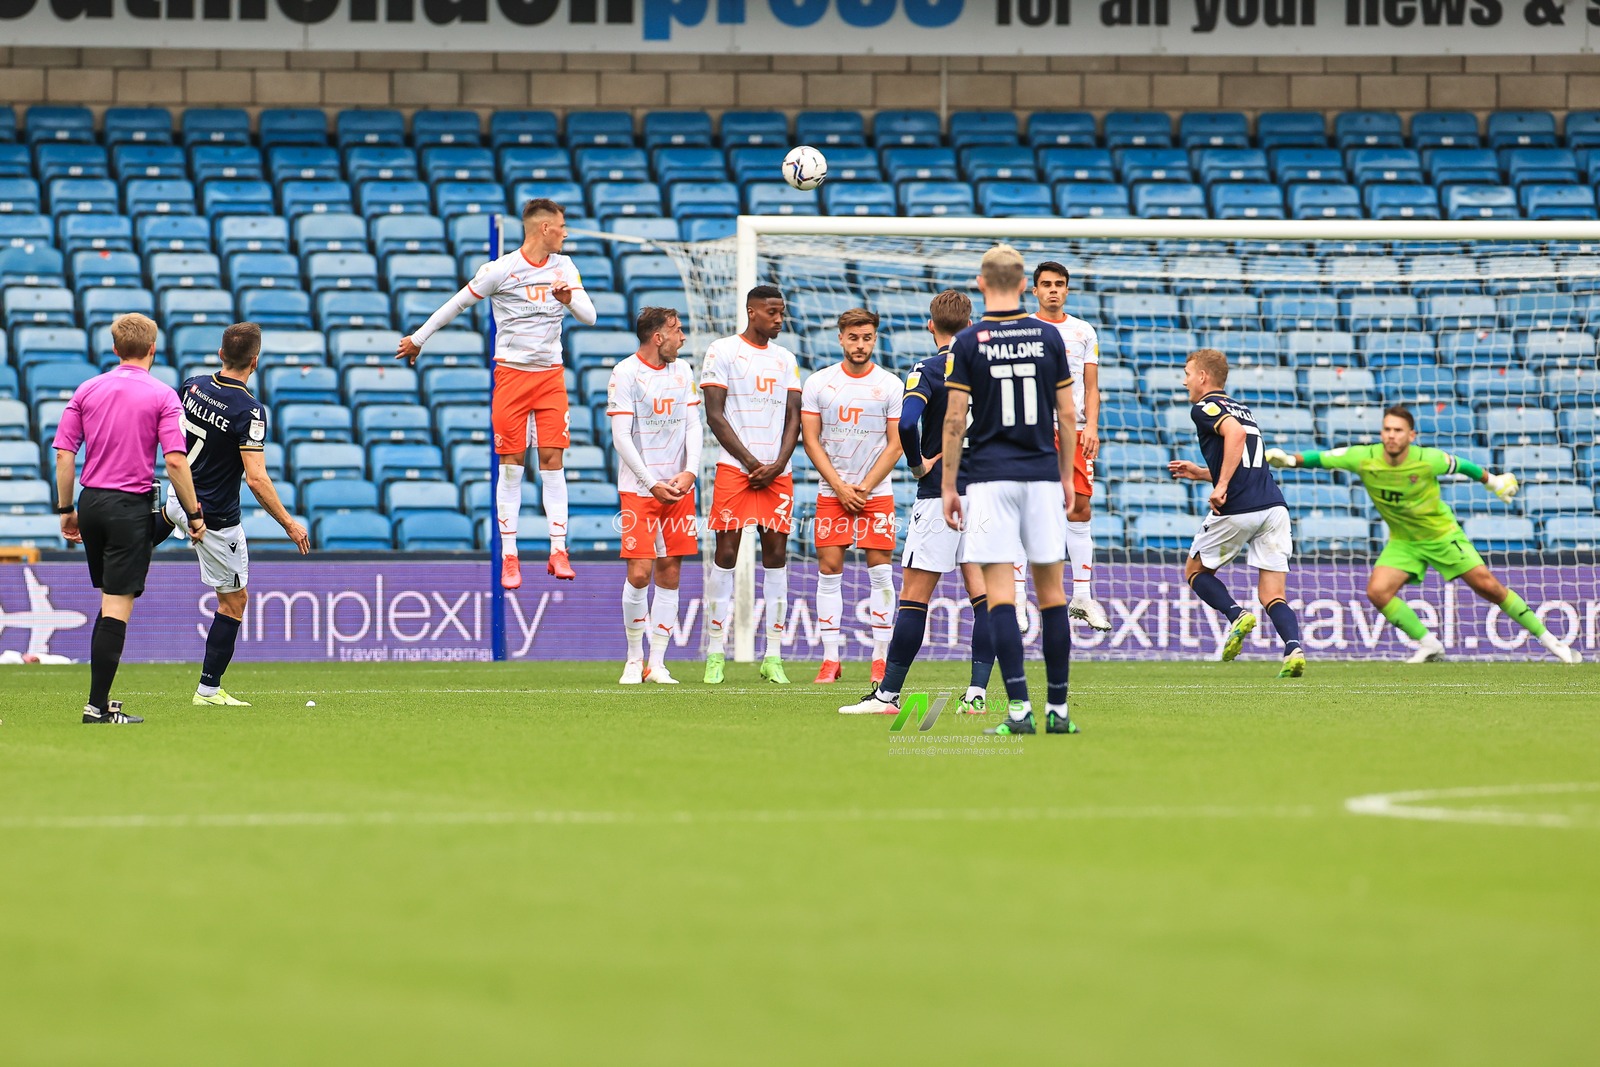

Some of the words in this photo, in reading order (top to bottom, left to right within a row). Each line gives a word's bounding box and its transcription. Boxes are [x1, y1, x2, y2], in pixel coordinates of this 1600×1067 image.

[525, 285, 550, 302] UT
[755, 375, 776, 395] UT
[654, 398, 674, 416] UT
[838, 405, 864, 425] UT
[1381, 489, 1403, 504] UT
